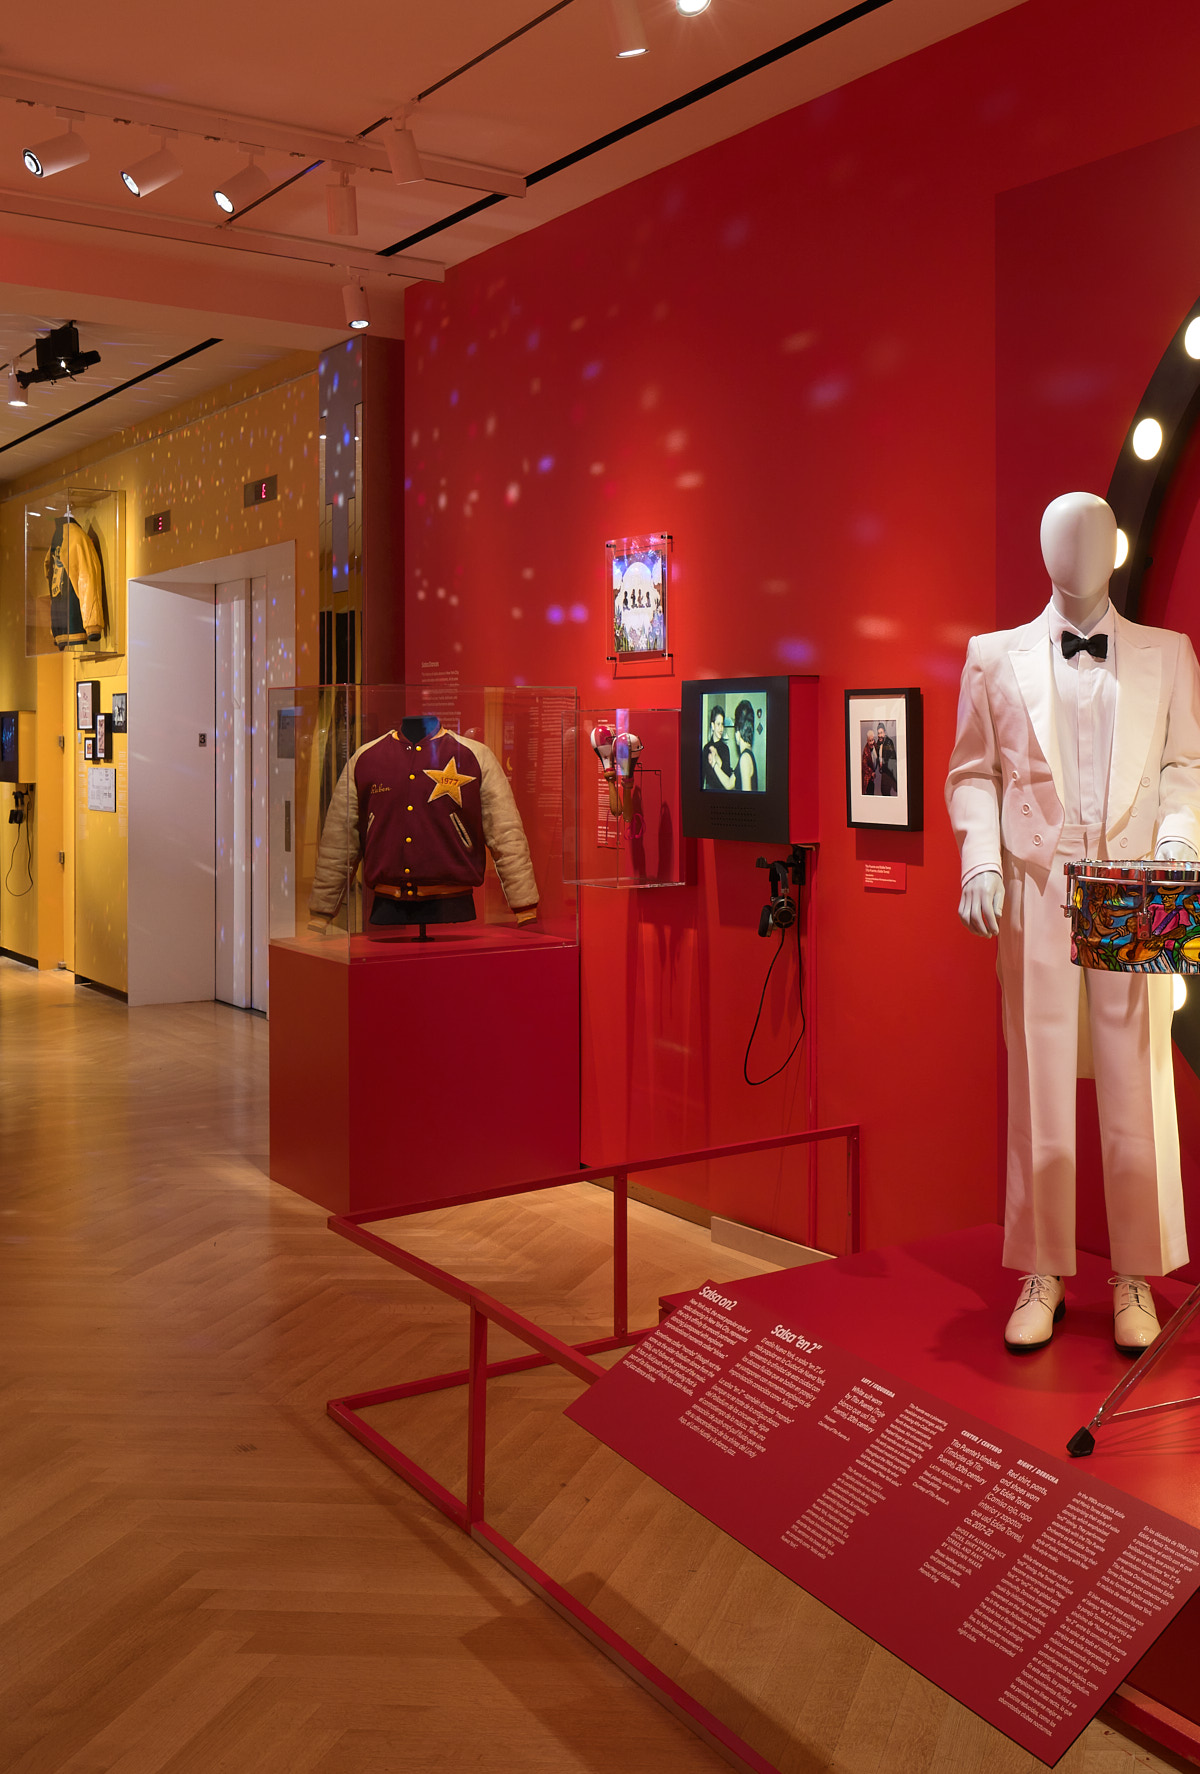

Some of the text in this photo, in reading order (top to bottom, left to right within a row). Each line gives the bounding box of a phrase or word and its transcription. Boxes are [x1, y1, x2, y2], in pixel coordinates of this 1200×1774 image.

[200, 734, 206, 744] 3
[441, 777, 459, 786] 1977
[699, 1286, 738, 1311] Salsa on2
[771, 1324, 797, 1343] Salsa
[872, 1384, 896, 1398] IZQUIERDA
[838, 1399, 853, 1411] blanco
[858, 1400, 874, 1412] Puente
[872, 1407, 886, 1418] (Traje
[831, 1406, 849, 1419] Puente),
[857, 1421, 875, 1434] century
[943, 1446, 967, 1463] (Timbales
[960, 1444, 981, 1459] Puente's
[979, 1455, 1002, 1470] timbales
[937, 1454, 987, 1486] Puente), 20th century
[1017, 1459, 1034, 1470] RIGHT
[1035, 1469, 1059, 1484] DERECHA
[1010, 1484, 1027, 1495] shoes
[1026, 1492, 1040, 1502] worn
[1017, 1476, 1031, 1487] shirt,
[1030, 1483, 1048, 1496] pants,
[985, 1492, 1033, 1522] (Camisa roja, ropa
[1000, 1488, 1016, 1501] Eddie
[1015, 1496, 1032, 1510] Torres
[978, 1500, 998, 1514] interior
[1000, 1514, 1023, 1529] zapatos
[990, 1519, 1006, 1532] Eddie
[1005, 1527, 1024, 1543] Torres),
